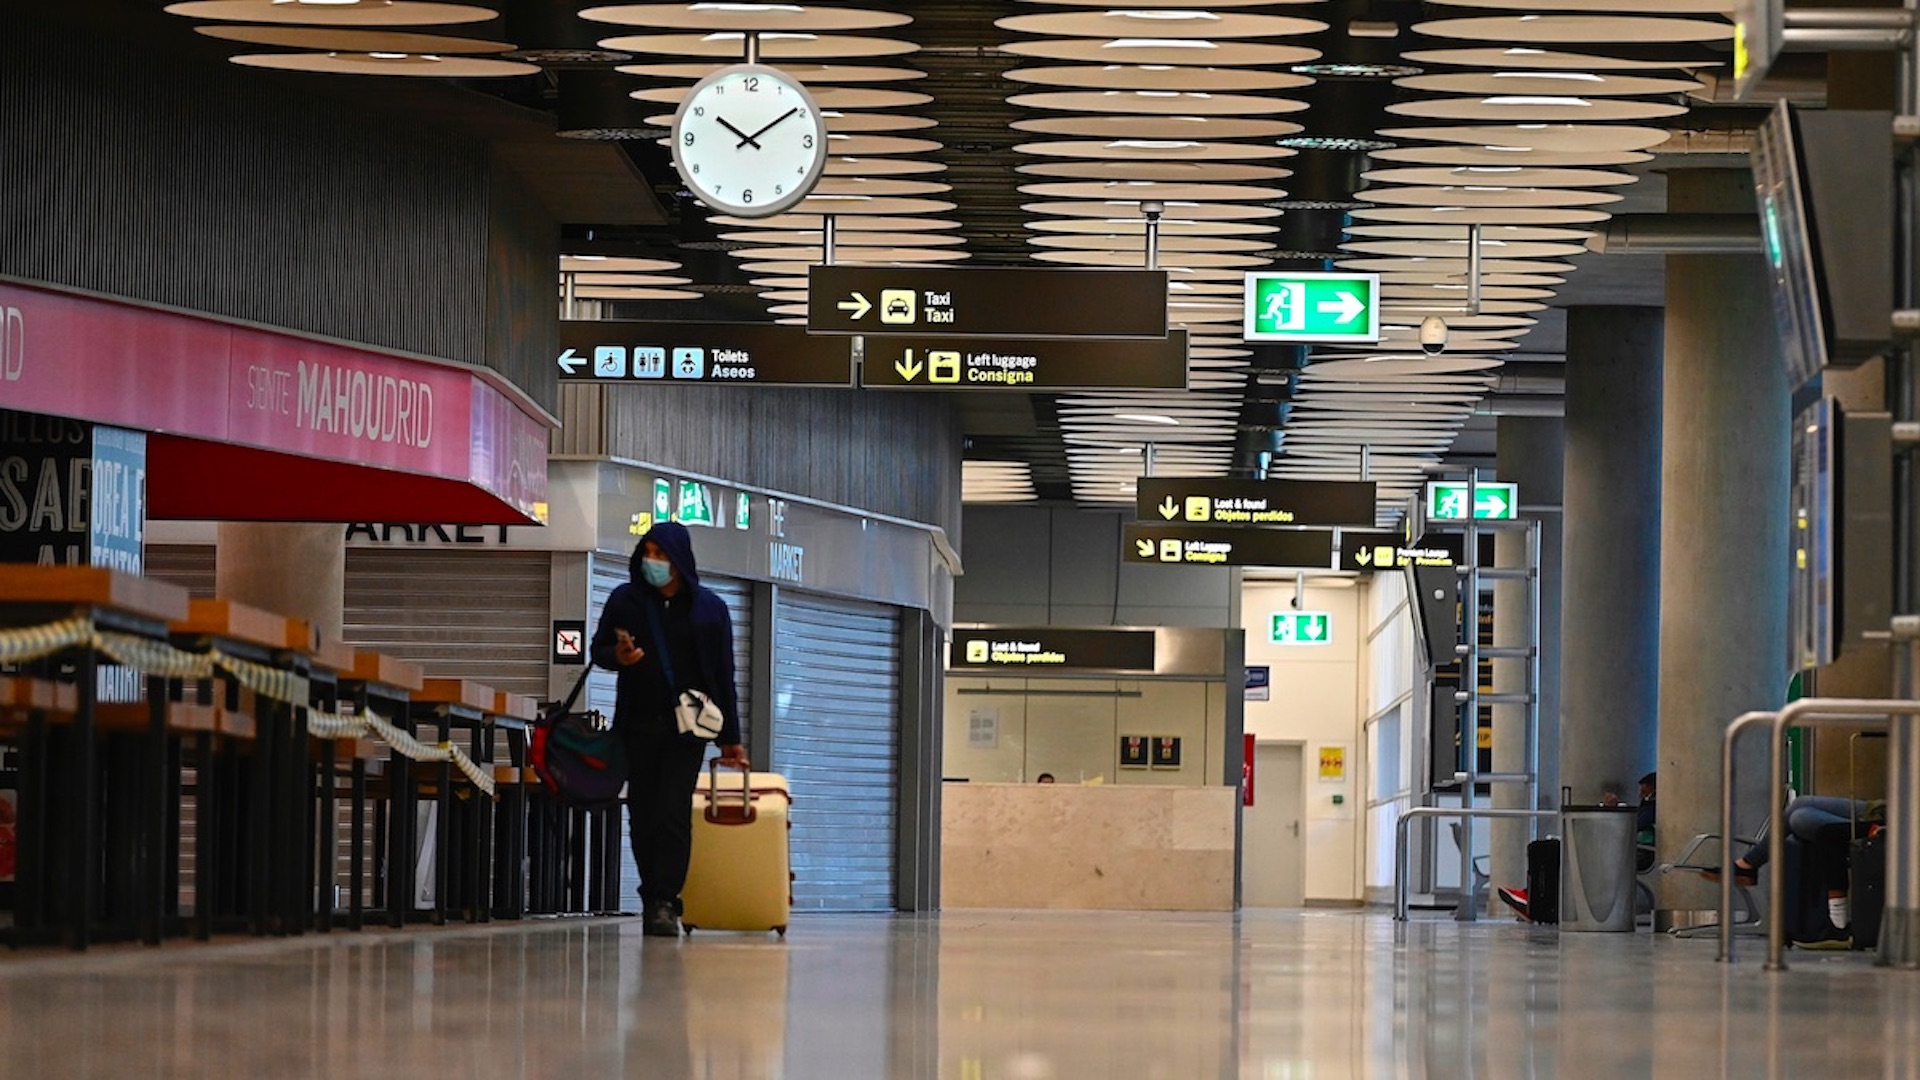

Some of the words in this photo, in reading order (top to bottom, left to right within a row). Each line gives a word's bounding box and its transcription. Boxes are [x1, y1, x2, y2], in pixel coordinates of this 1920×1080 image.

[716, 86, 724, 94] 11
[743, 77, 758, 92] 12
[694, 106, 704, 116] 10
[799, 108, 806, 118] 2
[684, 132, 694, 146] 9
[803, 135, 812, 148] 3
[693, 164, 700, 174] 8
[797, 166, 804, 174] 4
[715, 185, 722, 194] 7
[743, 189, 752, 203] 6
[775, 185, 782, 194] 5
[924, 291, 950, 306] Taxi
[924, 308, 954, 323] Taxi
[711, 349, 750, 363] Toilets
[967, 353, 991, 366] Left
[992, 353, 1037, 369] luggage
[711, 364, 756, 379] Aseos
[967, 368, 1034, 384] Consigna
[247, 364, 292, 415] SIENTE
[296, 360, 432, 449] MAHOUDRID
[1214, 498, 1234, 509] Lost
[1234, 498, 1242, 509] &
[1243, 498, 1266, 510] found
[768, 499, 784, 538] THE
[1214, 509, 1251, 522] Objetos
[1252, 510, 1294, 523] perdidos
[770, 542, 804, 582] MARKET
